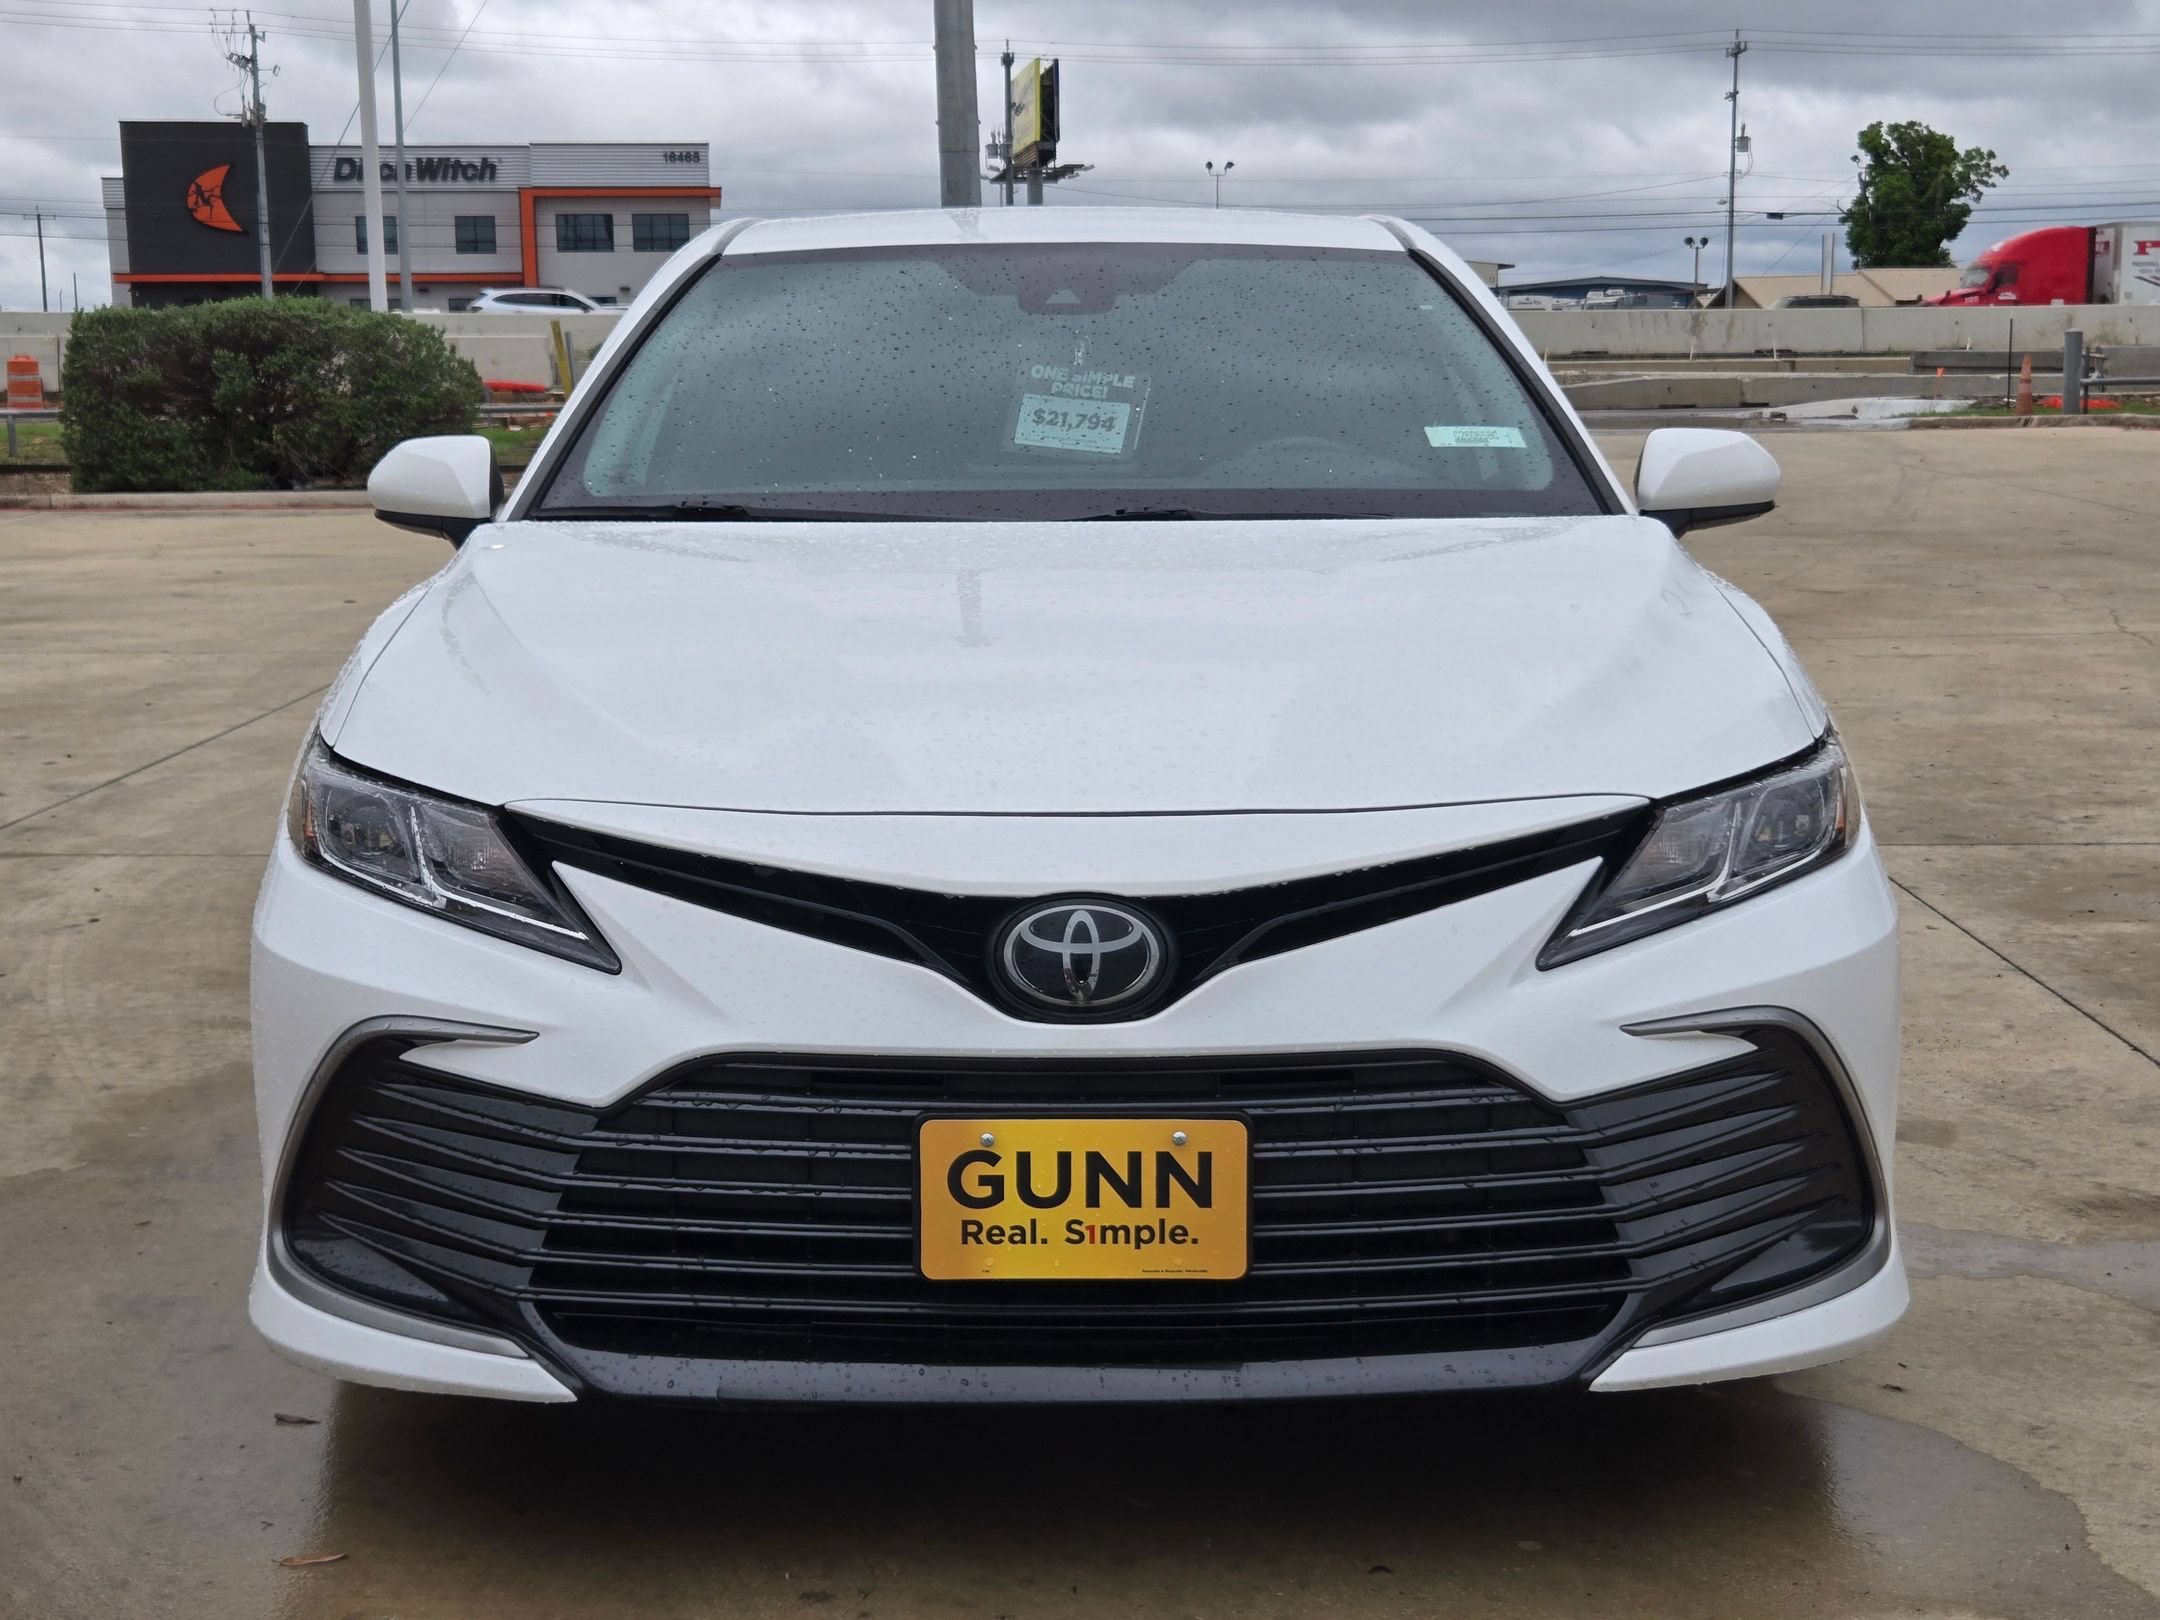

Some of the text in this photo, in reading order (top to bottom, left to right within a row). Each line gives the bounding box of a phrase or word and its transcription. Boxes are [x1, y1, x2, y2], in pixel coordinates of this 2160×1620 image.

[415, 157, 497, 182] Witch
[1031, 364, 1069, 382] ONE
[1051, 381, 1109, 399] PRICE!
[1032, 408, 1117, 432] $21,794
[947, 1149, 1213, 1210] GUNN
[960, 1218, 1199, 1250] Real. S1mple.
